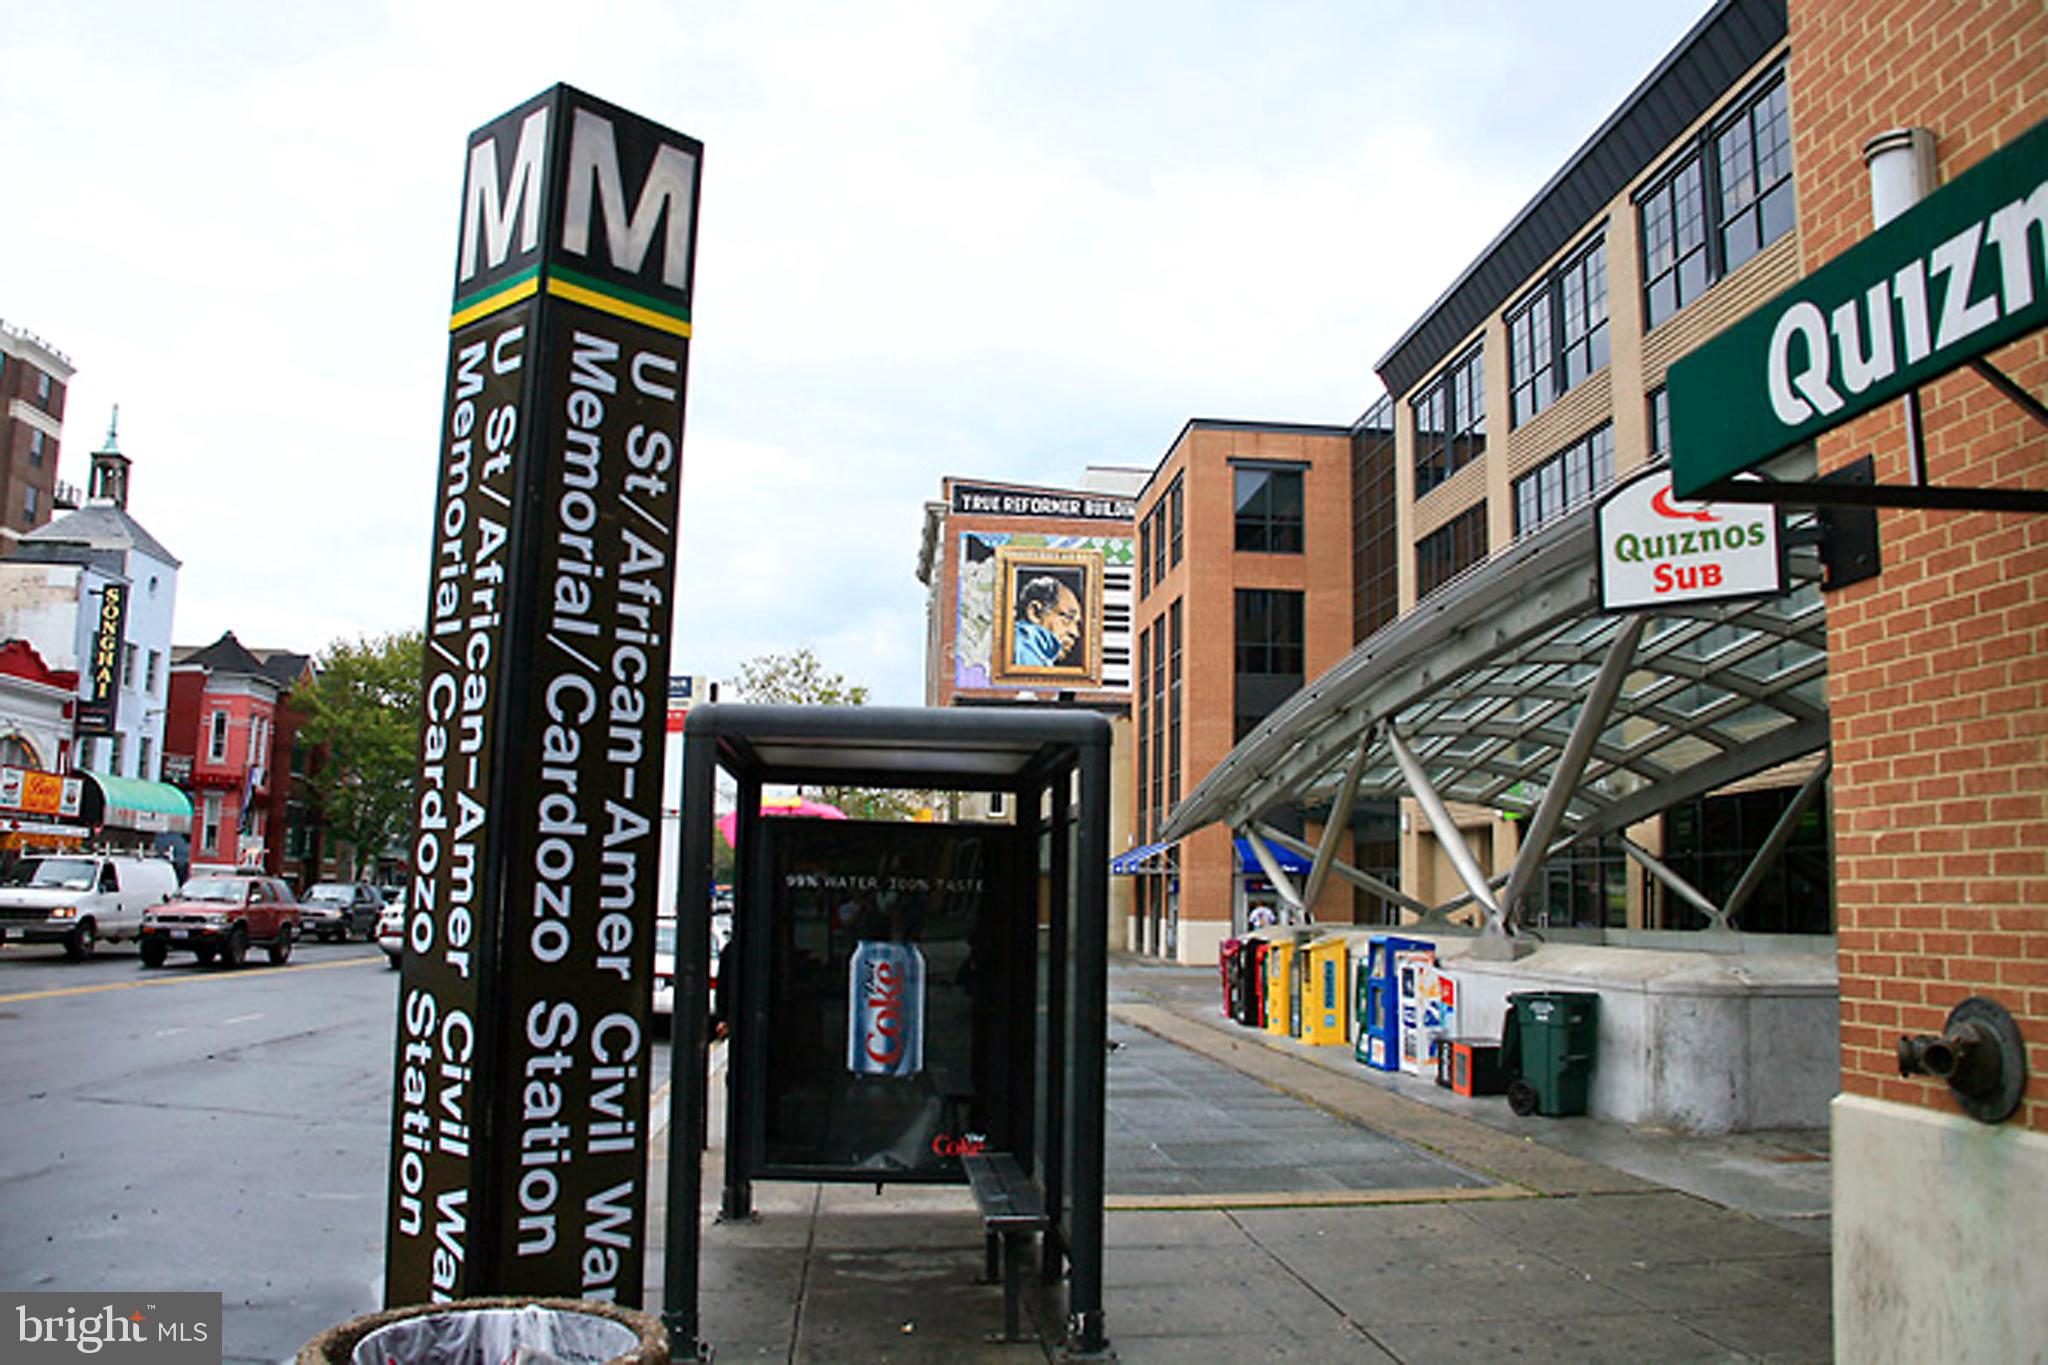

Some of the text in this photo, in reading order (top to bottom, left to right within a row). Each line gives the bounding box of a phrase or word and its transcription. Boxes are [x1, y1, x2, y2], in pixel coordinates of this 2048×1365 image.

[460, 106, 549, 284] M
[562, 106, 697, 291] M
[493, 325, 525, 375] U
[631, 351, 677, 401] U
[961, 494, 999, 511] TRUE
[1003, 496, 1080, 515] REFORMER
[97, 587, 120, 699] SONGHAI
[399, 340, 487, 1237] Memorial/Cardozo Station
[518, 331, 620, 1256] Memorial/Cardozo Station
[785, 874, 819, 888] 99%
[937, 878, 985, 893] TASTE
[865, 962, 904, 1064] Coke
[439, 1010, 474, 1158] Civil
[588, 1013, 640, 1153] Civil
[931, 1134, 987, 1157] Coke
